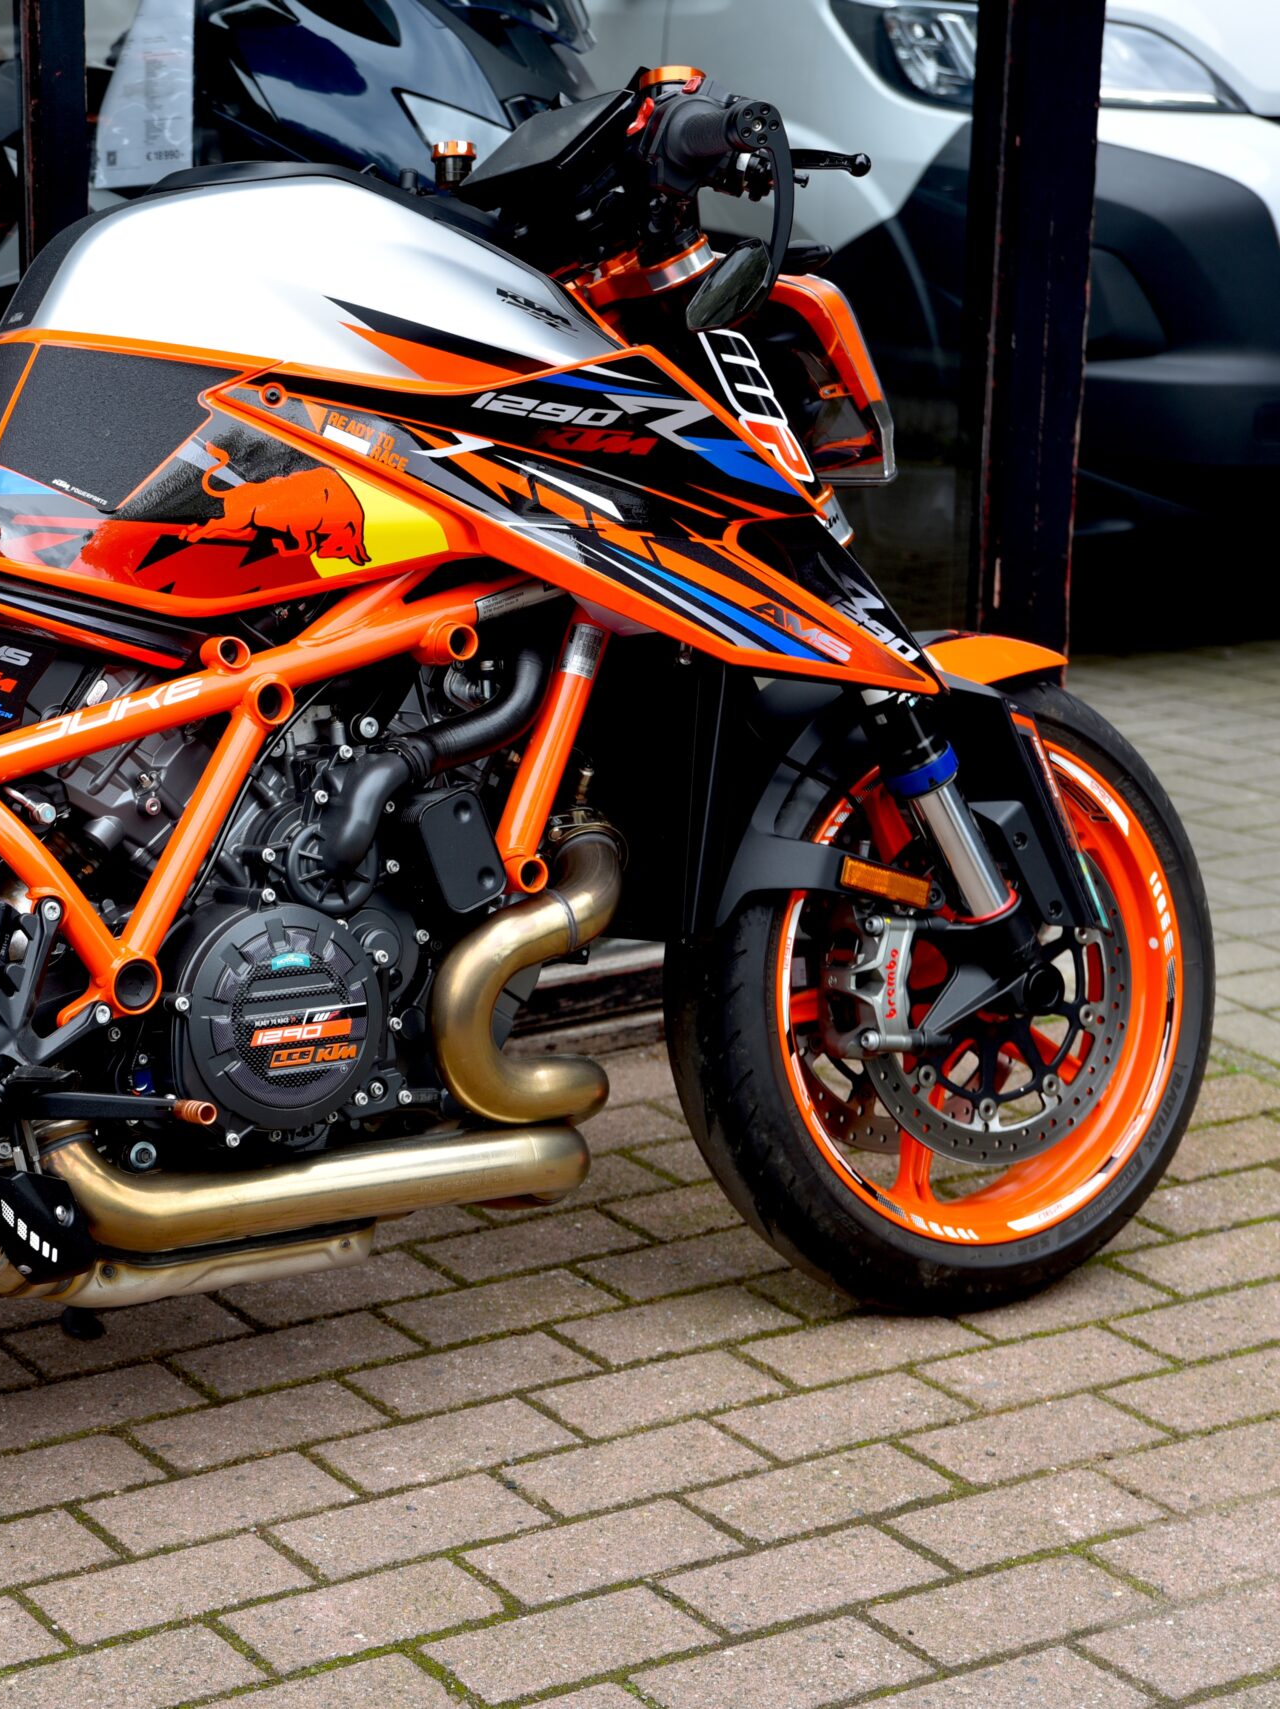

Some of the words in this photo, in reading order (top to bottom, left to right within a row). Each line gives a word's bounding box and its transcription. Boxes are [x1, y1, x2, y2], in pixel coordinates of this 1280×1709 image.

[471, 391, 624, 427] 1290
[327, 411, 376, 440] READY
[377, 431, 395, 451] TO
[531, 426, 659, 456] KTM
[370, 446, 408, 472] RACE
[751, 602, 852, 662] AMS
[885, 948, 899, 1020] brembo
[255, 1019, 270, 1028] READY
[278, 1016, 290, 1024] RACE
[257, 1024, 323, 1045] 1290
[316, 1042, 358, 1062] KTM
